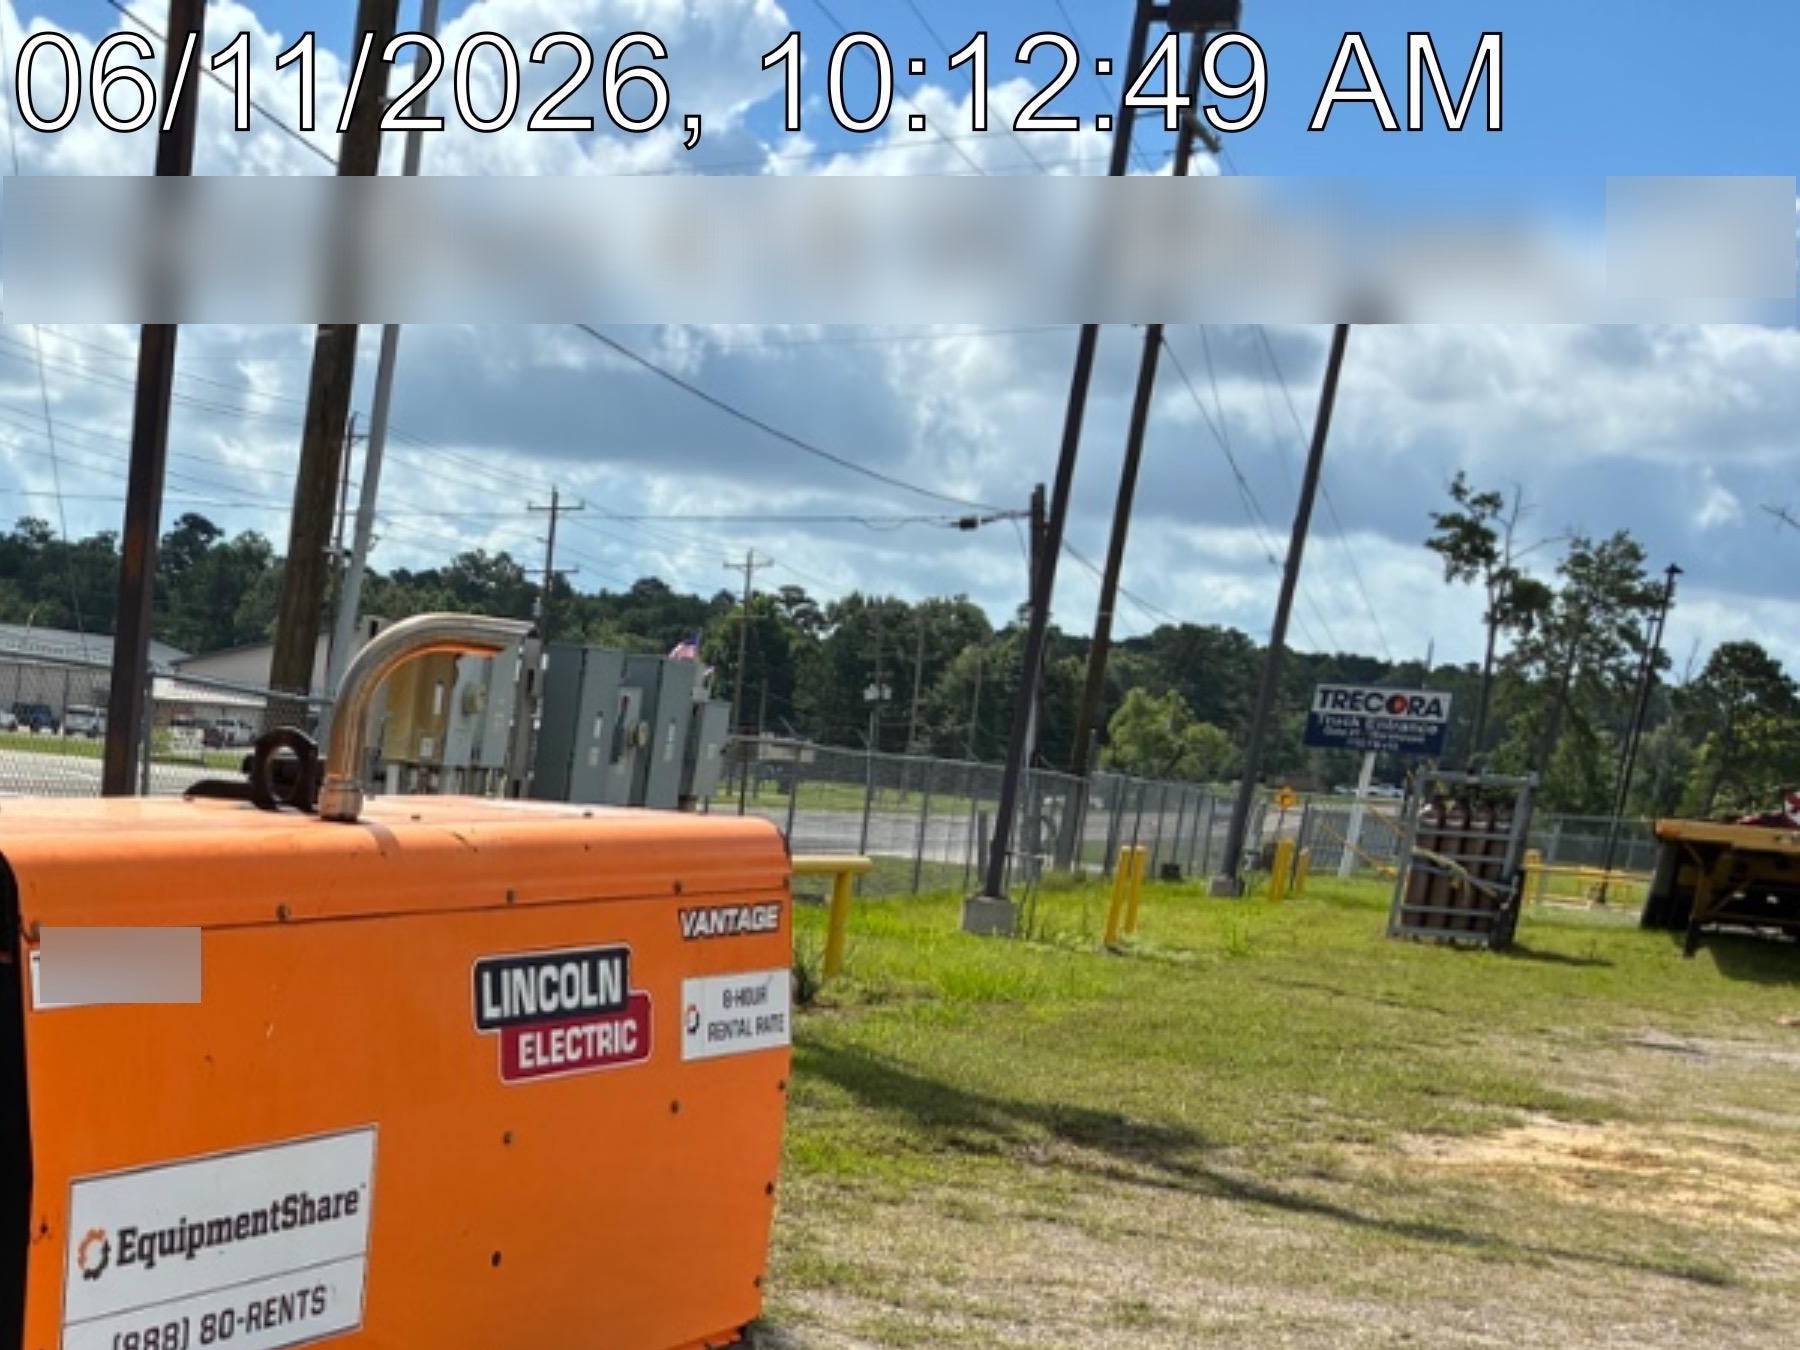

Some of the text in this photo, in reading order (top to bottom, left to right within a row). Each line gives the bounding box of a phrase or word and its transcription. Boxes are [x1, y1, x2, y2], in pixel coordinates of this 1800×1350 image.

[1319, 689, 1443, 718] TRECORA
[680, 904, 780, 938] VANTAGE
[482, 957, 623, 1020] LINCOLN
[517, 1018, 638, 1071] ELECTRIC
[707, 1013, 785, 1042] RENTAL RATE
[116, 1188, 361, 1269] EquipmentShare
[199, 1285, 327, 1345] 80-RENTS
